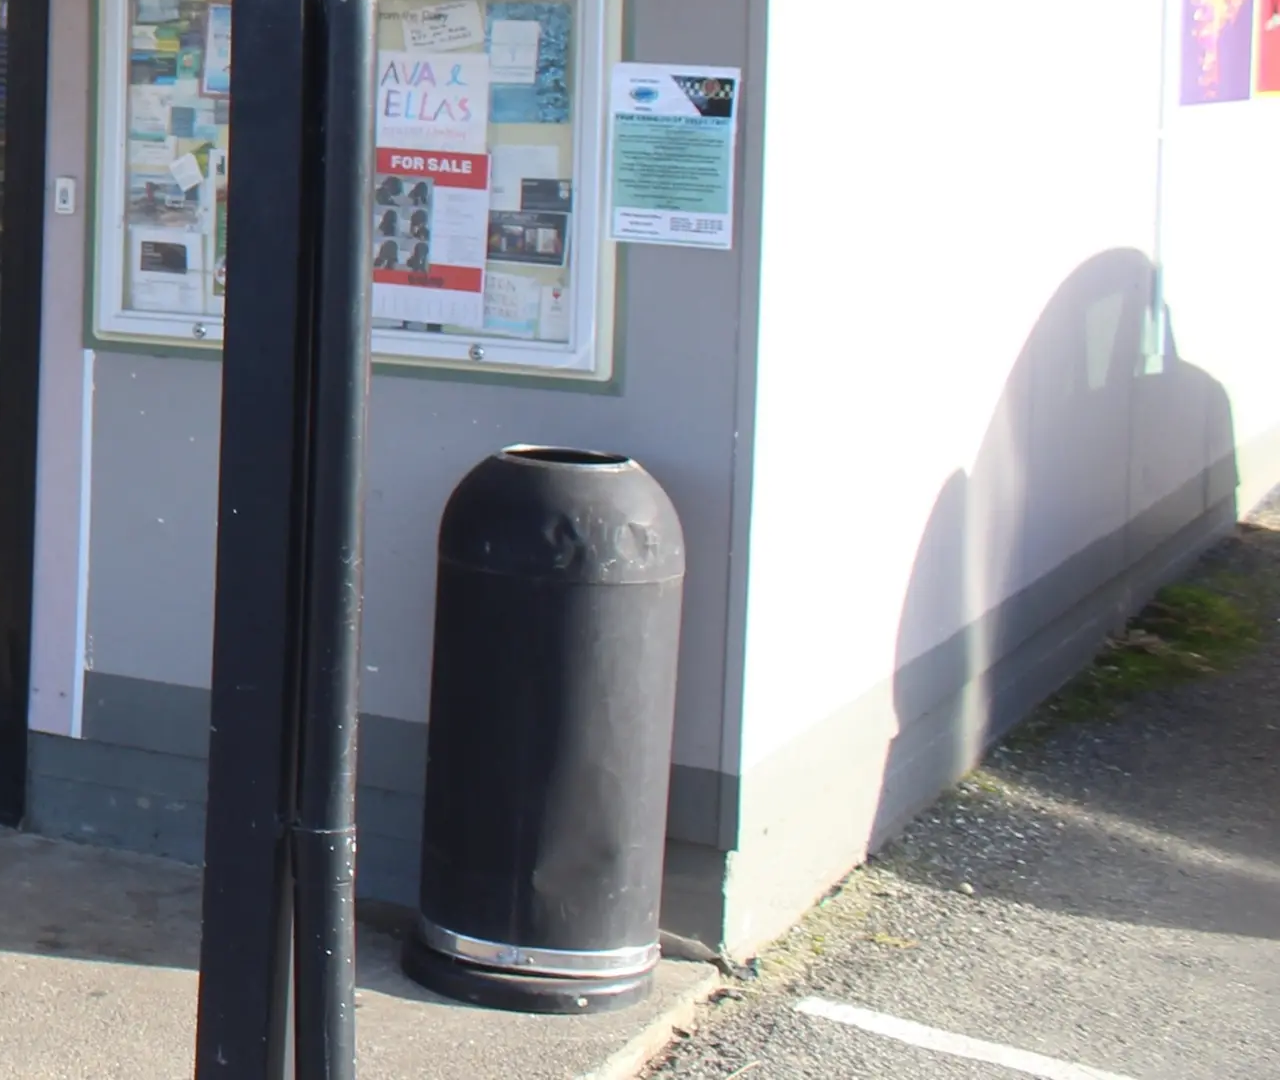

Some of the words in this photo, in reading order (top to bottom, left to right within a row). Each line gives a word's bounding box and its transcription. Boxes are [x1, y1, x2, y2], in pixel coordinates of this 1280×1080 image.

[381, 60, 436, 87] AVA
[391, 155, 425, 170] FOR
[427, 158, 473, 174] SALE
